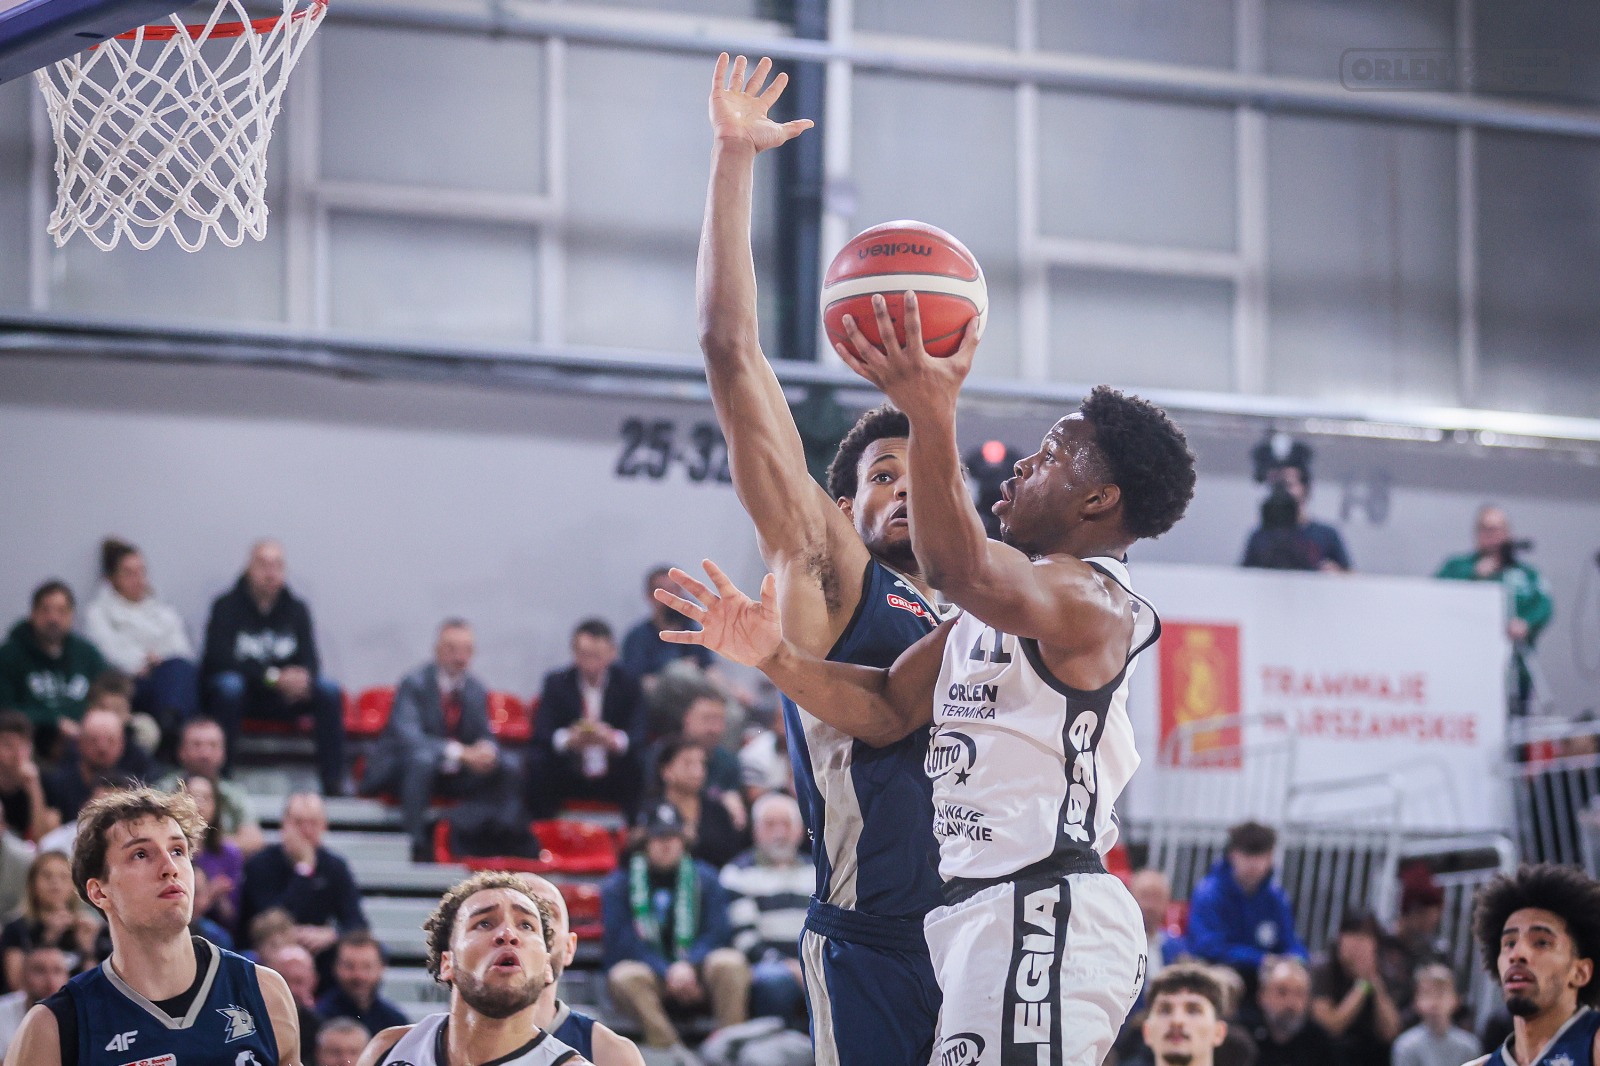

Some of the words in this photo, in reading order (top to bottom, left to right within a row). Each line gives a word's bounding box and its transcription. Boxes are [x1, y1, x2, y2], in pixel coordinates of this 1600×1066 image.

[858, 242, 932, 259] molten
[949, 683, 999, 703] ORLEN
[942, 703, 996, 720] TERMIKA
[927, 744, 961, 773] LOTTO
[1063, 710, 1099, 843] 1929
[105, 1030, 139, 1052] 4F
[941, 1041, 968, 1066] OTTO
